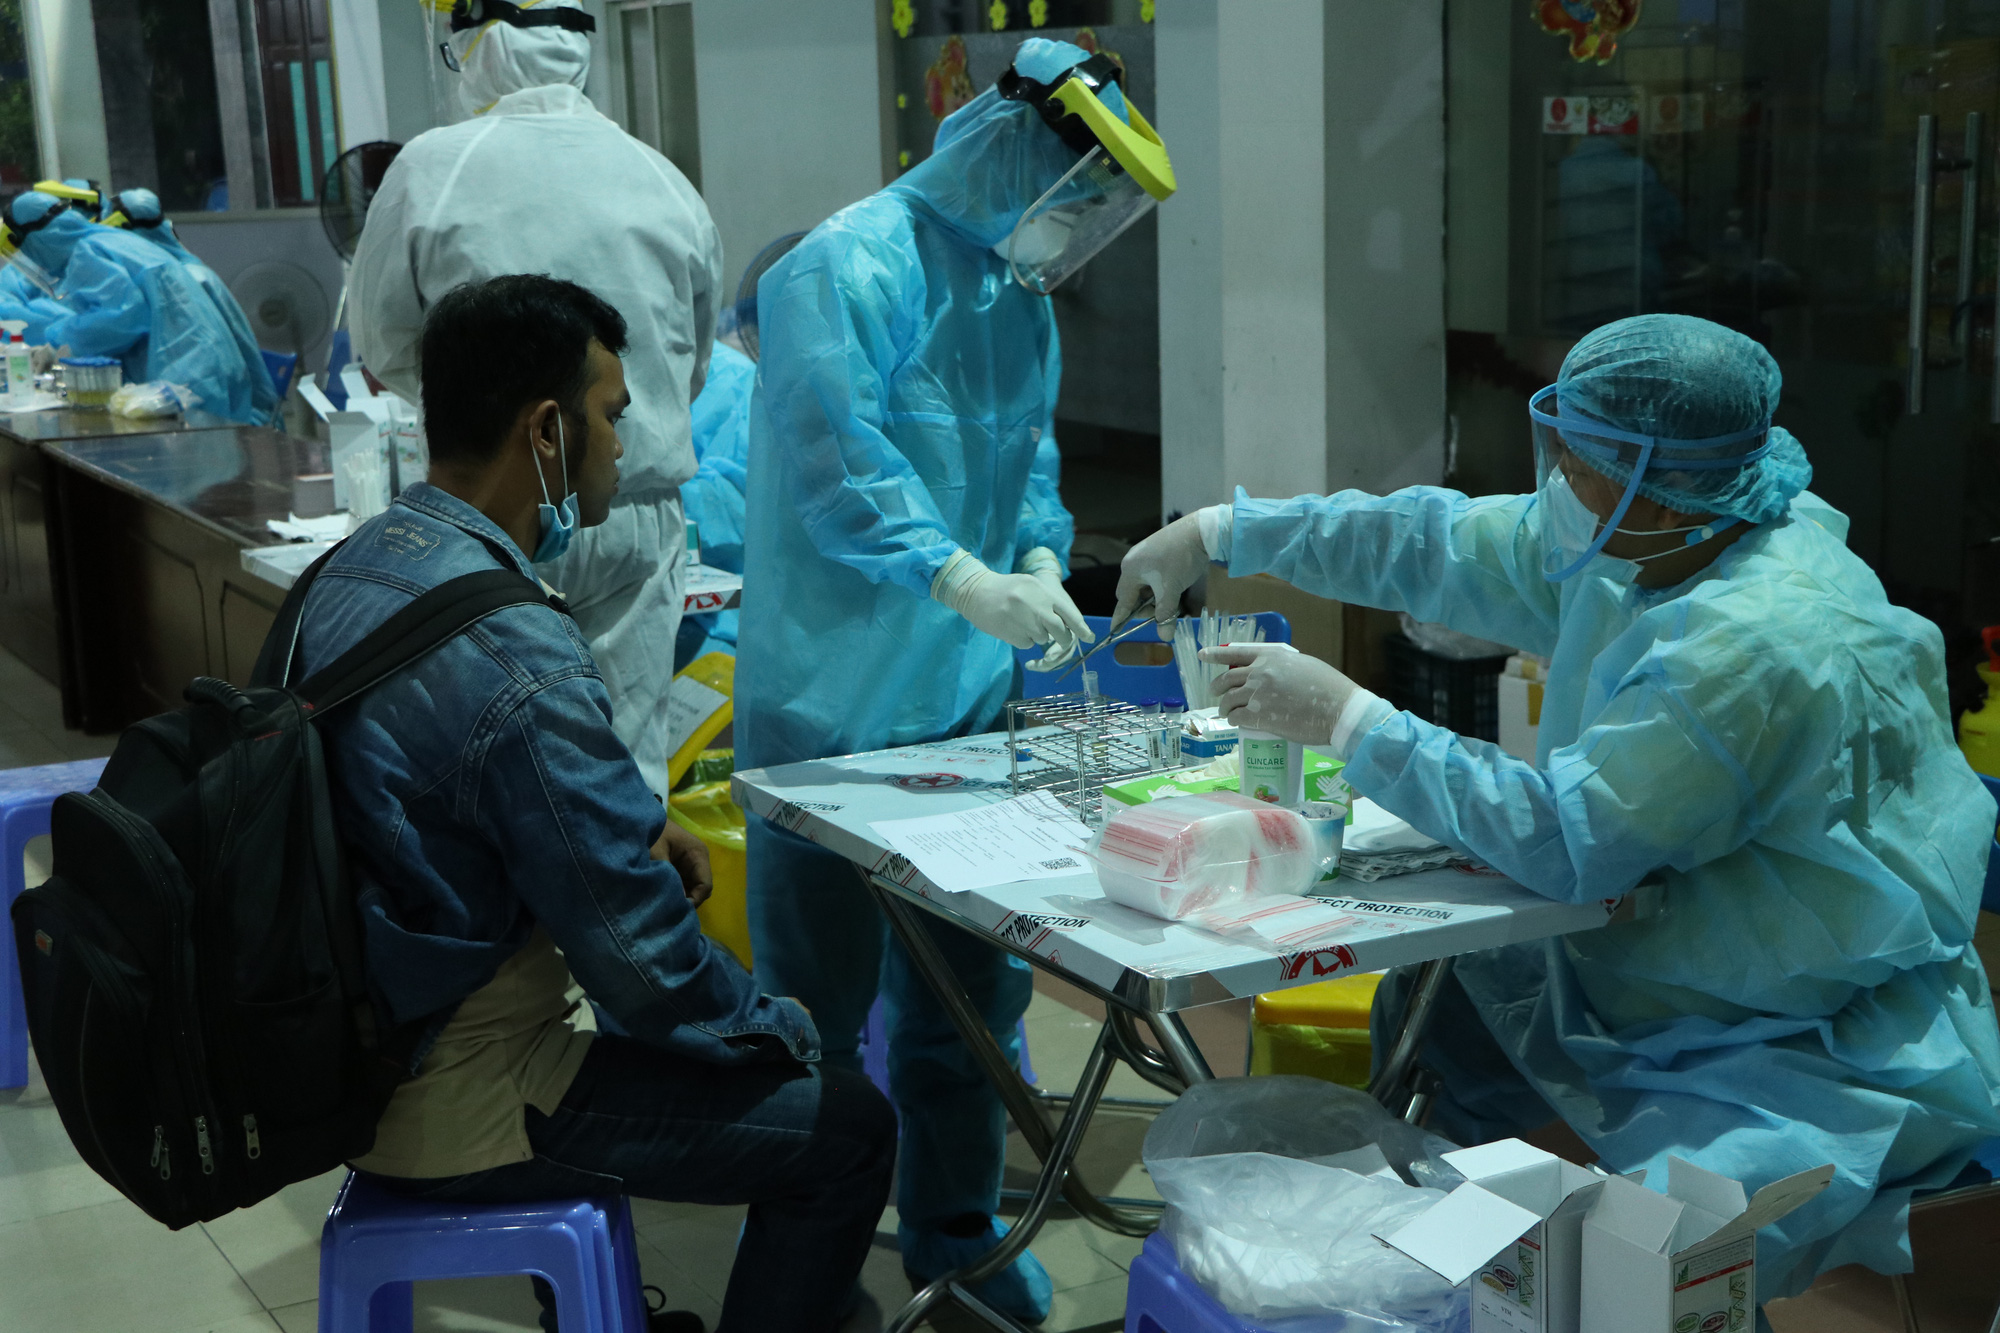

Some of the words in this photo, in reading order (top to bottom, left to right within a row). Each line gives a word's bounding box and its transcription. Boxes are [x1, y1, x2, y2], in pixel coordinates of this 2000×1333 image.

[1247, 757, 1285, 766] CLINCARE
[1354, 902, 1453, 920] PROTECTION
[1013, 914, 1091, 943] PROTECTION
[1304, 944, 1341, 959] CHOICE
